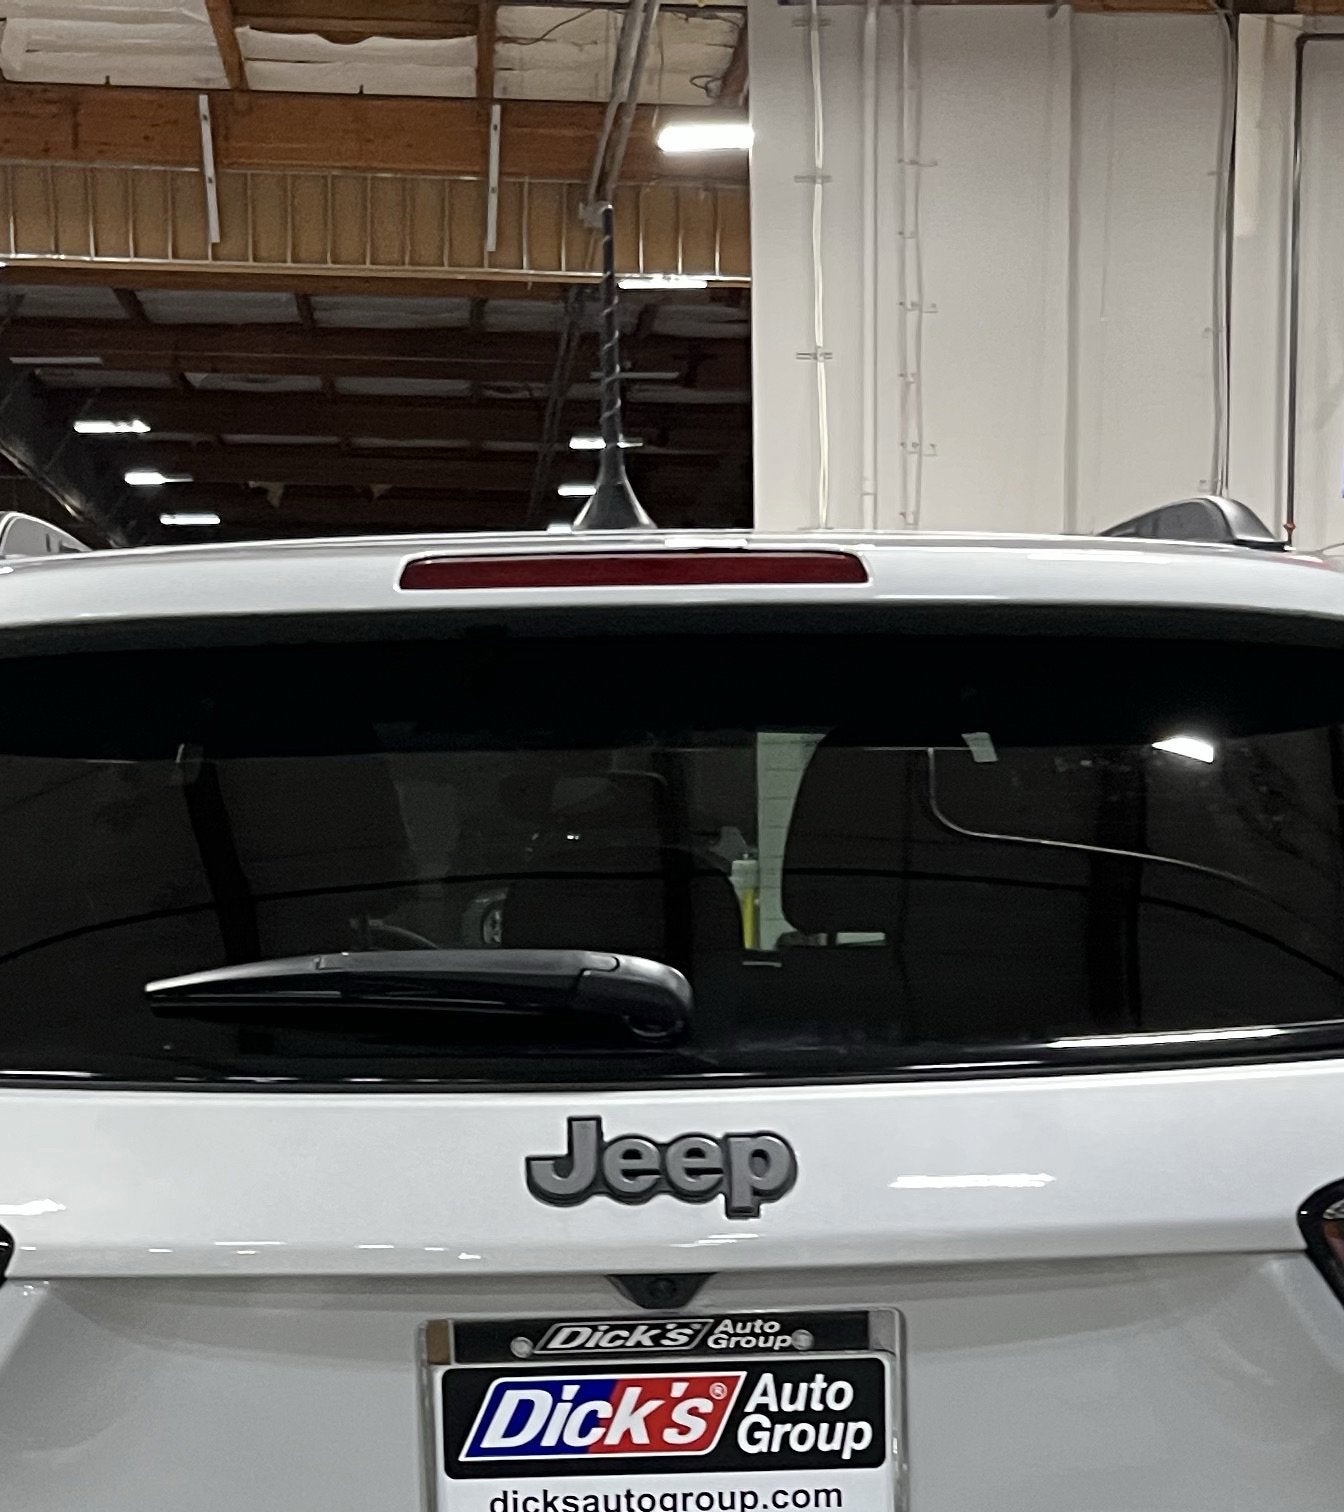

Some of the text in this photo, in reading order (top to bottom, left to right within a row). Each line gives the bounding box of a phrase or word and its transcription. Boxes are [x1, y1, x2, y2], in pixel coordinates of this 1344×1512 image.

[525, 1115, 798, 1219] Jeep
[546, 1320, 701, 1350] Dick's
[707, 1333, 793, 1351] Group
[711, 1319, 781, 1334] Auto
[743, 1373, 855, 1413] Auto
[479, 1379, 714, 1449] Dick's
[737, 1414, 874, 1460] Group
